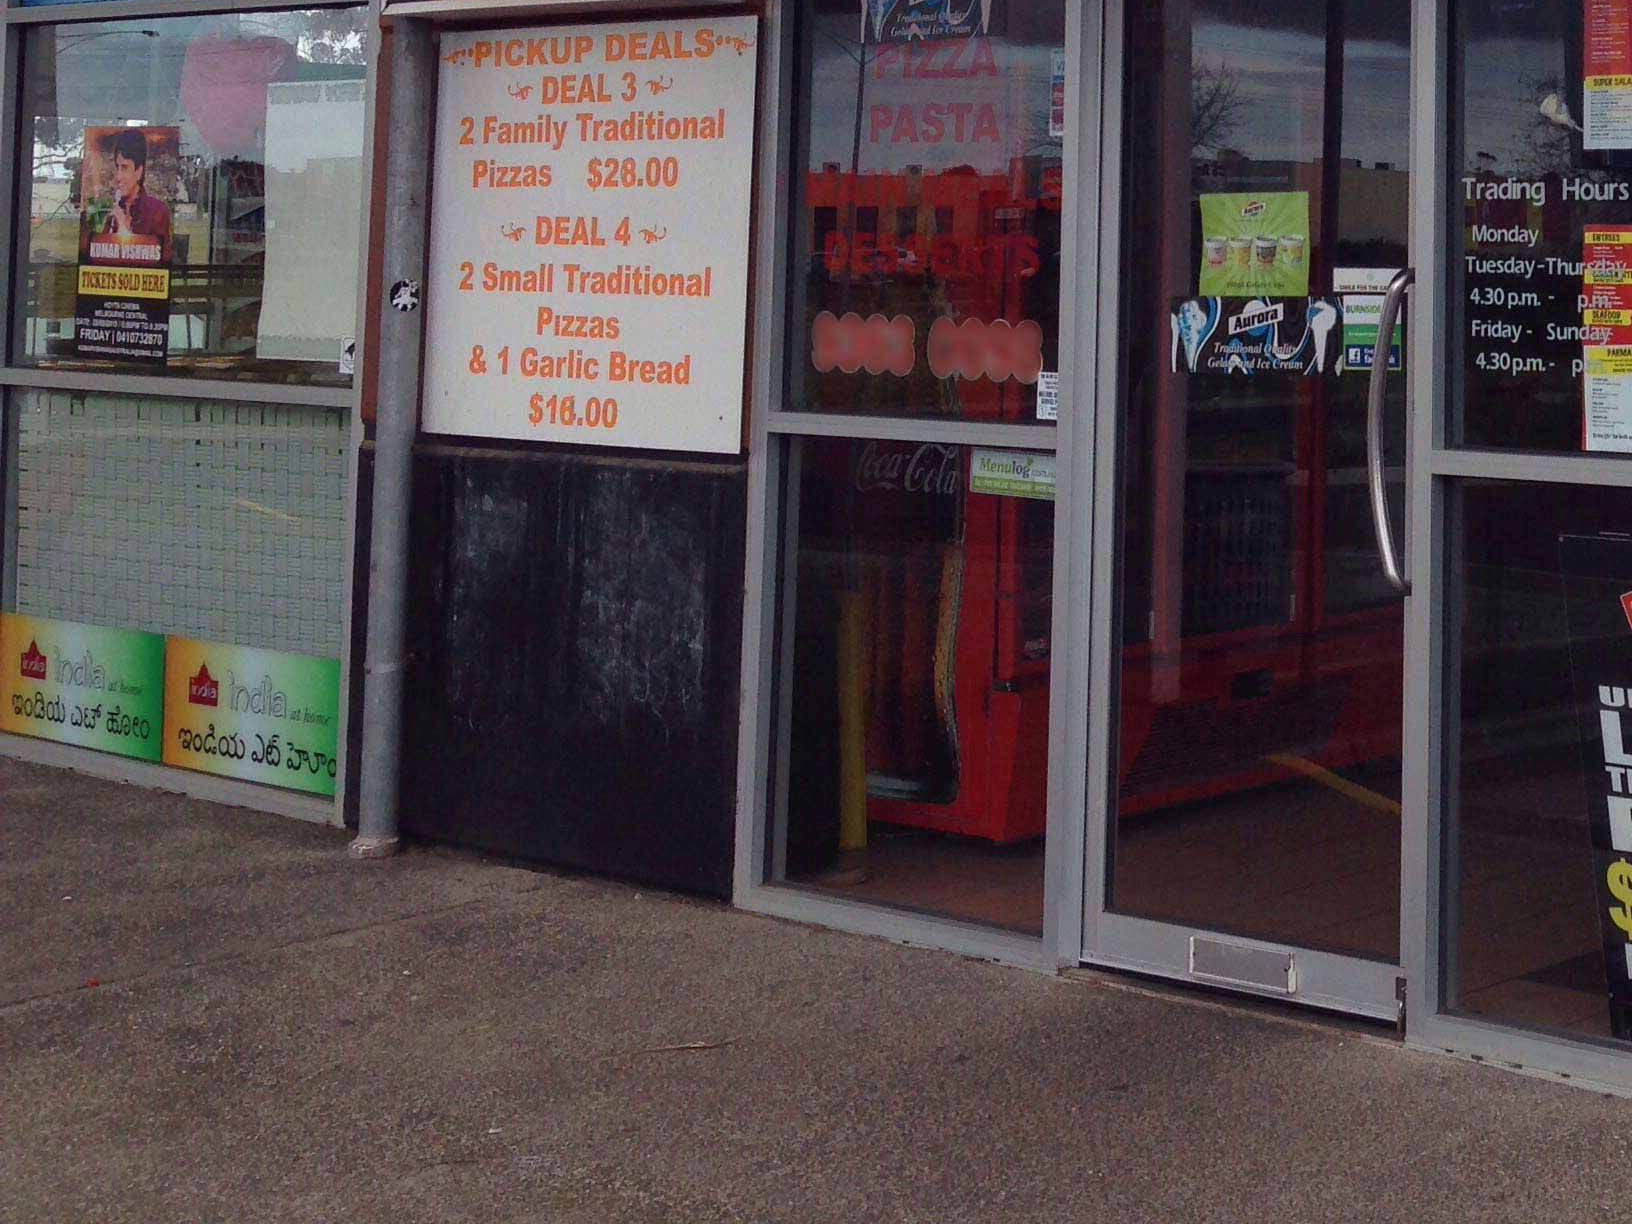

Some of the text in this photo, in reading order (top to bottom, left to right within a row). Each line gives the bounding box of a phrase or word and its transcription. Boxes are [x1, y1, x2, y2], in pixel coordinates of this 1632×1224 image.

[473, 29, 717, 68] PICKUP DEALS
[875, 37, 1000, 80] PIZZA
[541, 71, 638, 105] DEAL 3
[458, 108, 726, 151] 2 Family Traditional
[869, 102, 1002, 146] PASTA
[472, 156, 680, 192] Pizzas $28.00
[1461, 177, 1631, 206] Trading Hours
[534, 215, 632, 247] DEAL 4
[1471, 224, 1540, 247] Monday
[81, 270, 117, 290] TICKETS
[141, 274, 165, 293] HERE
[458, 261, 712, 298] 2 Small Traditional
[1470, 287, 1505, 306] 4.30
[1507, 292, 1541, 309] p.m.
[536, 306, 620, 340] Pizzas
[1233, 306, 1279, 332] Aurora
[1471, 319, 1523, 343] Friday
[1546, 323, 1610, 345] Sunday
[79, 327, 110, 342] FRIDAY
[1214, 341, 1264, 355] Traditional
[468, 344, 692, 386] & 1 Garlic Bread
[1475, 352, 1511, 370] 4.30
[1511, 357, 1547, 376] p.m.
[980, 457, 1031, 479] Menulog
